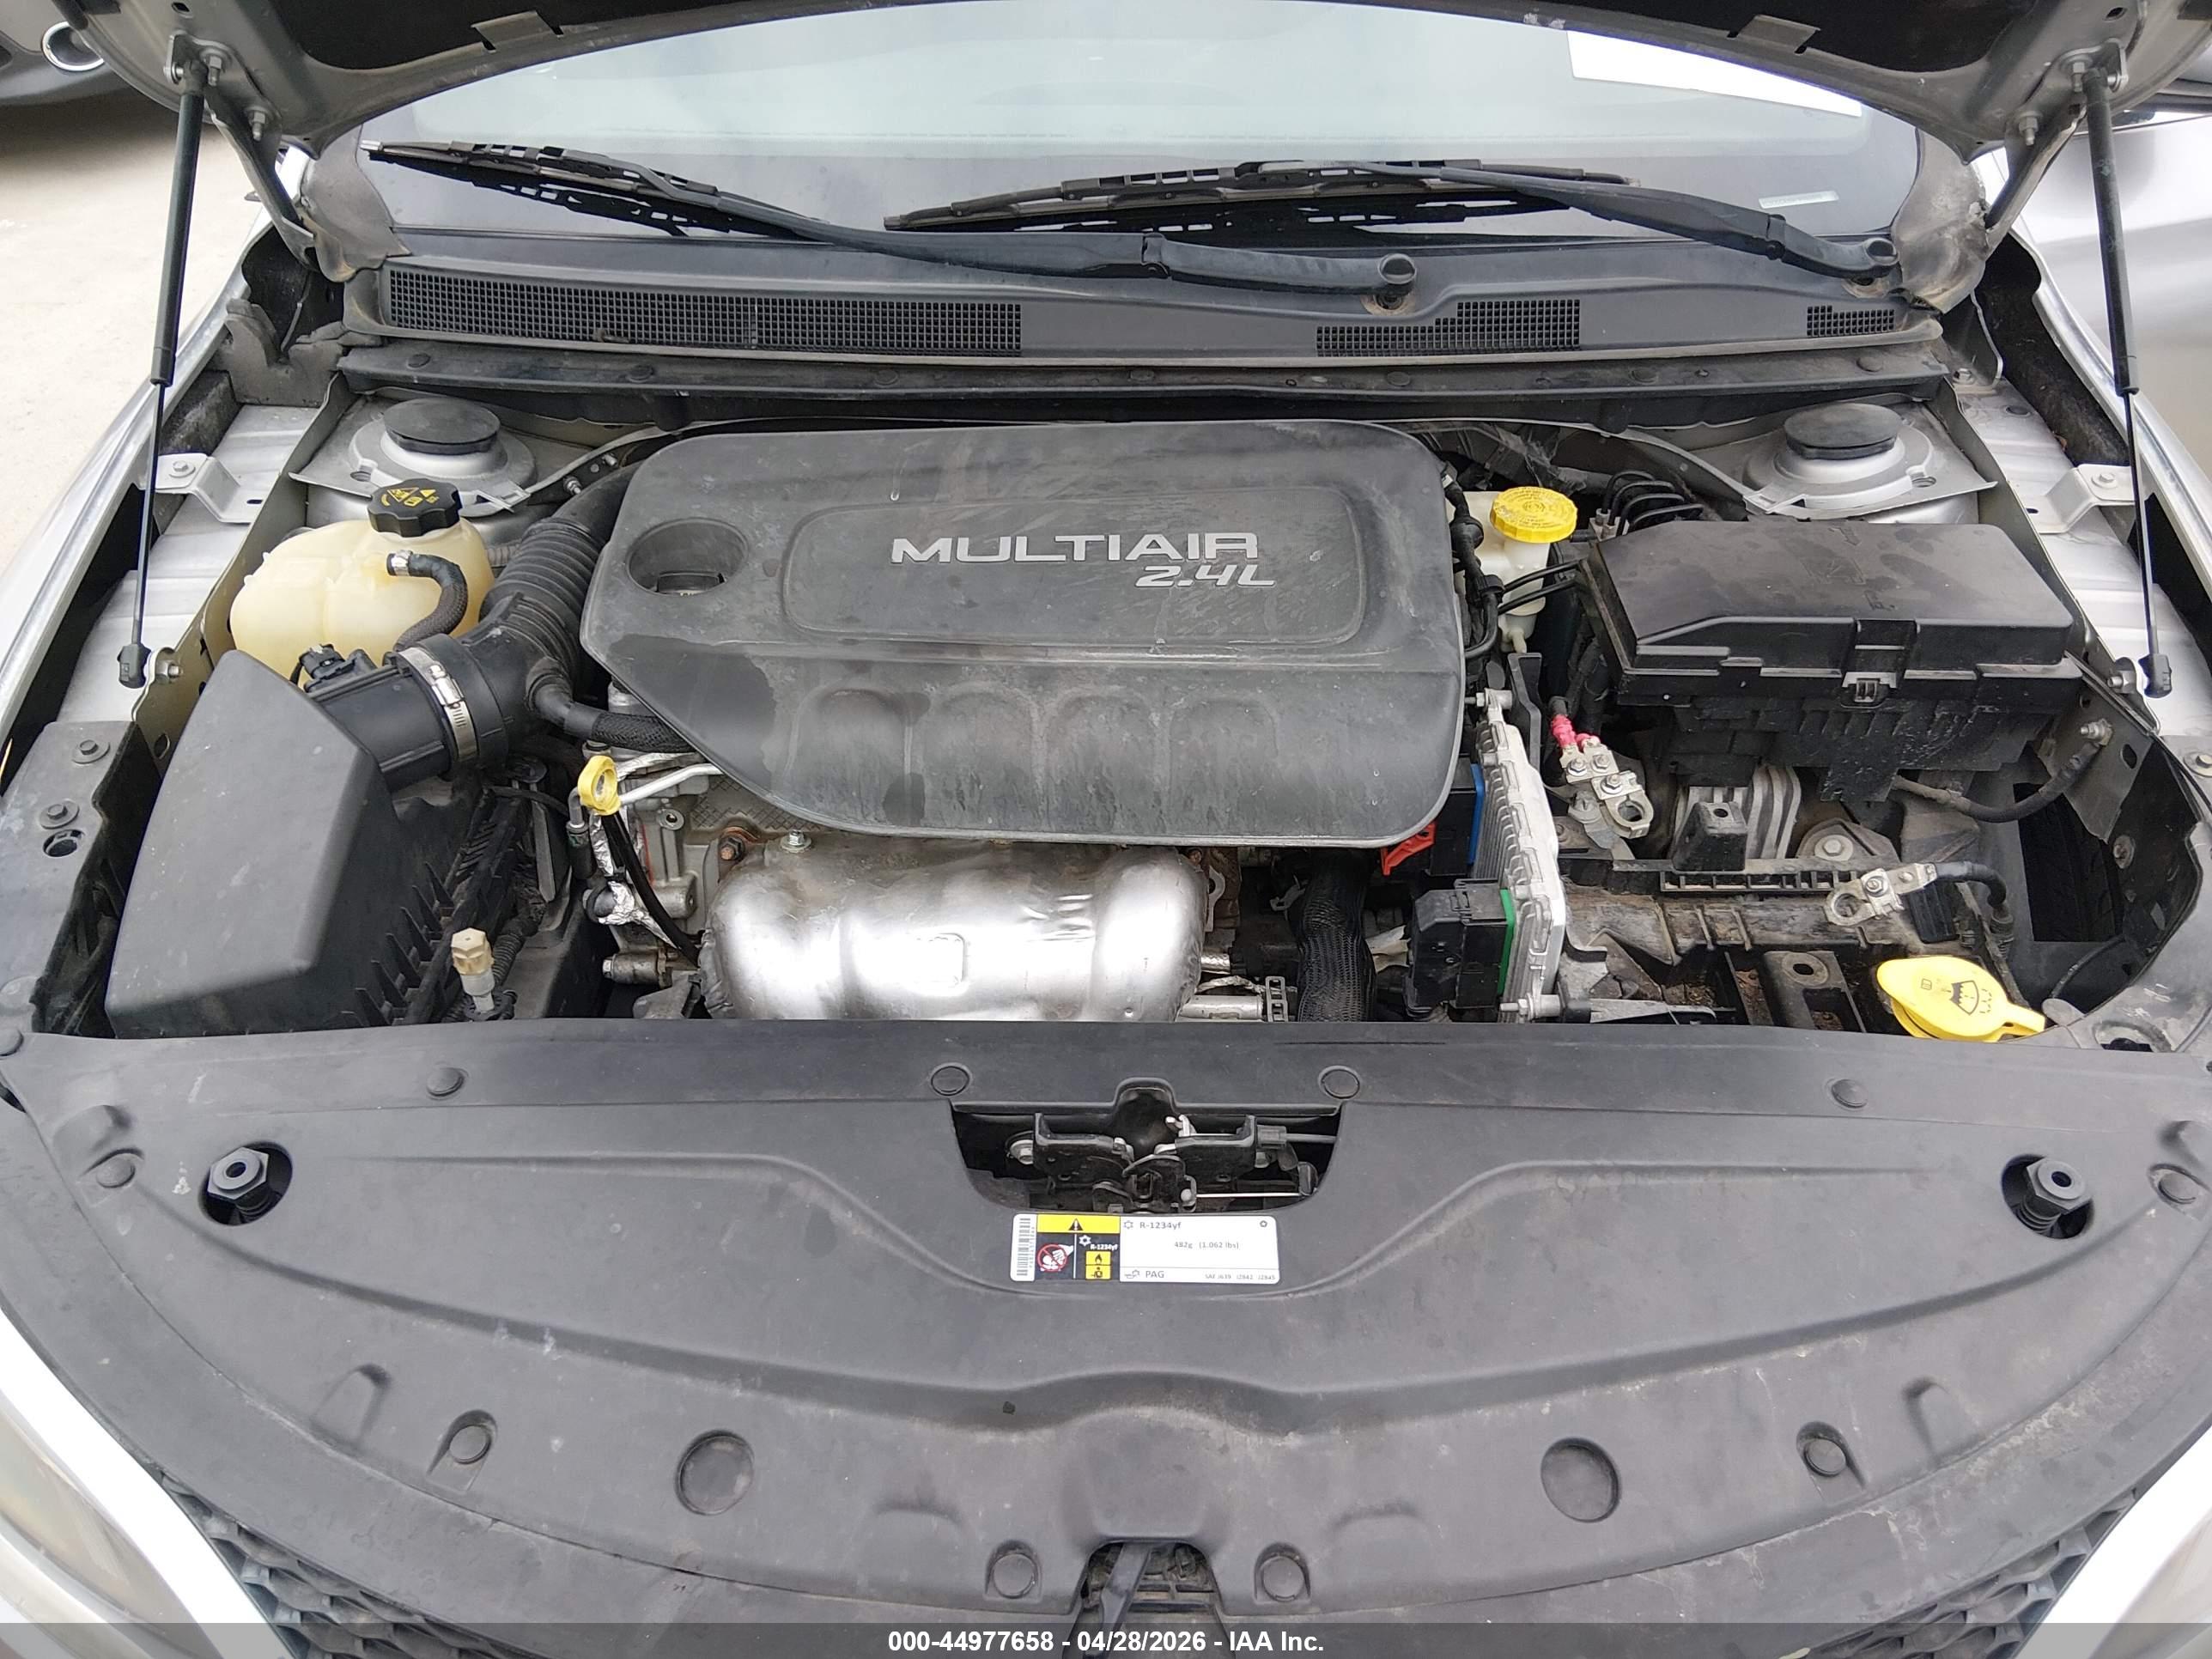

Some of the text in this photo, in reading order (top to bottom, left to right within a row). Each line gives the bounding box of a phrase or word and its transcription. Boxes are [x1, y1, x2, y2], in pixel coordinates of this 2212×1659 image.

[890, 532, 1259, 563] MULTIAIR
[1135, 563, 1276, 587] 2.4L
[1139, 1221, 1182, 1230] R-1234yf
[1146, 1270, 1164, 1279] PAG
